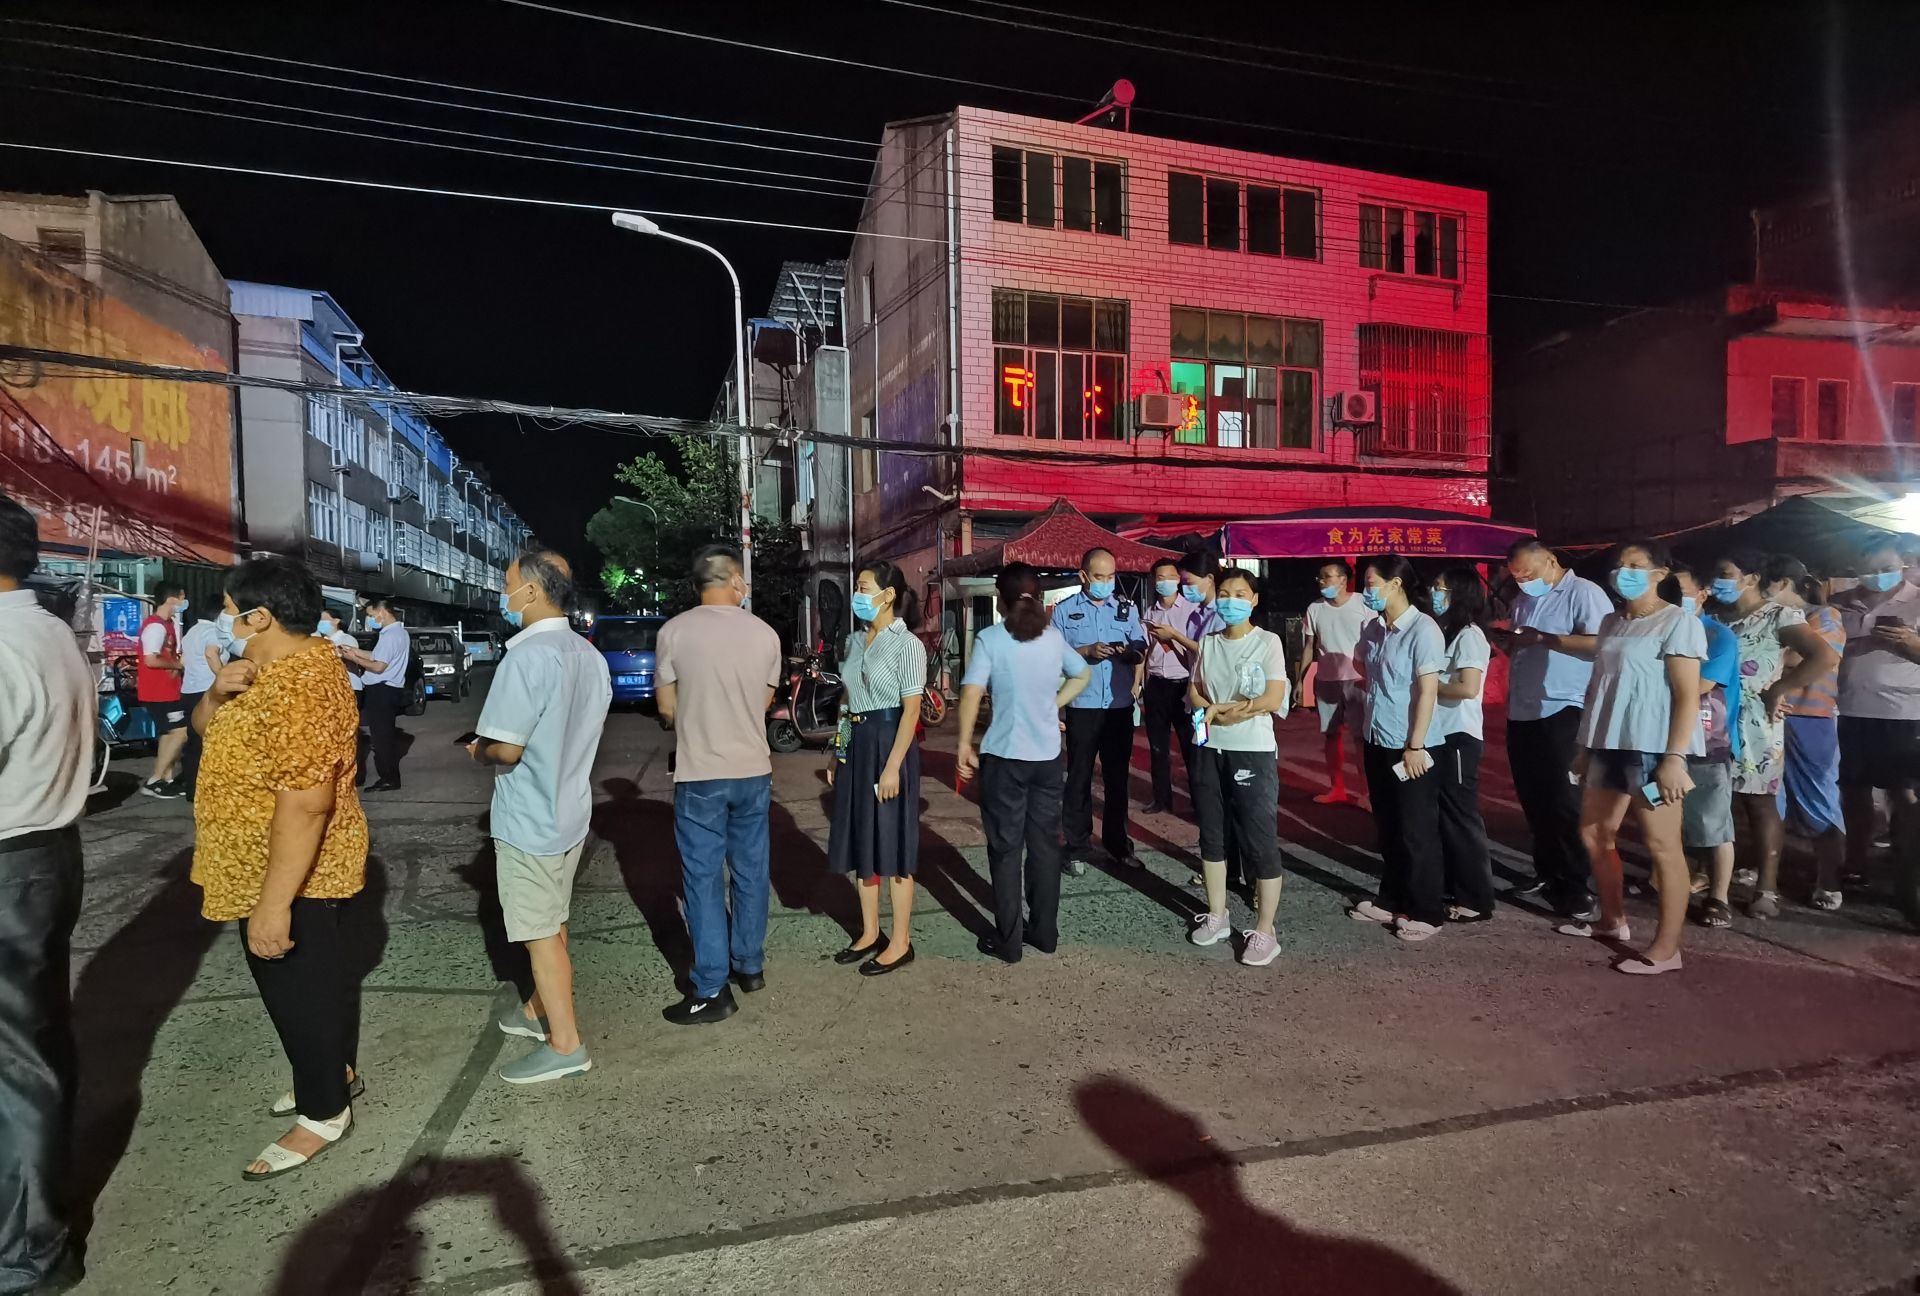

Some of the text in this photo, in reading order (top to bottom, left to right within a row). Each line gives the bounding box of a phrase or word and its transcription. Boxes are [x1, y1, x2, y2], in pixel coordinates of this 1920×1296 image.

[1327, 526, 1442, 545] 食为先家常菜
